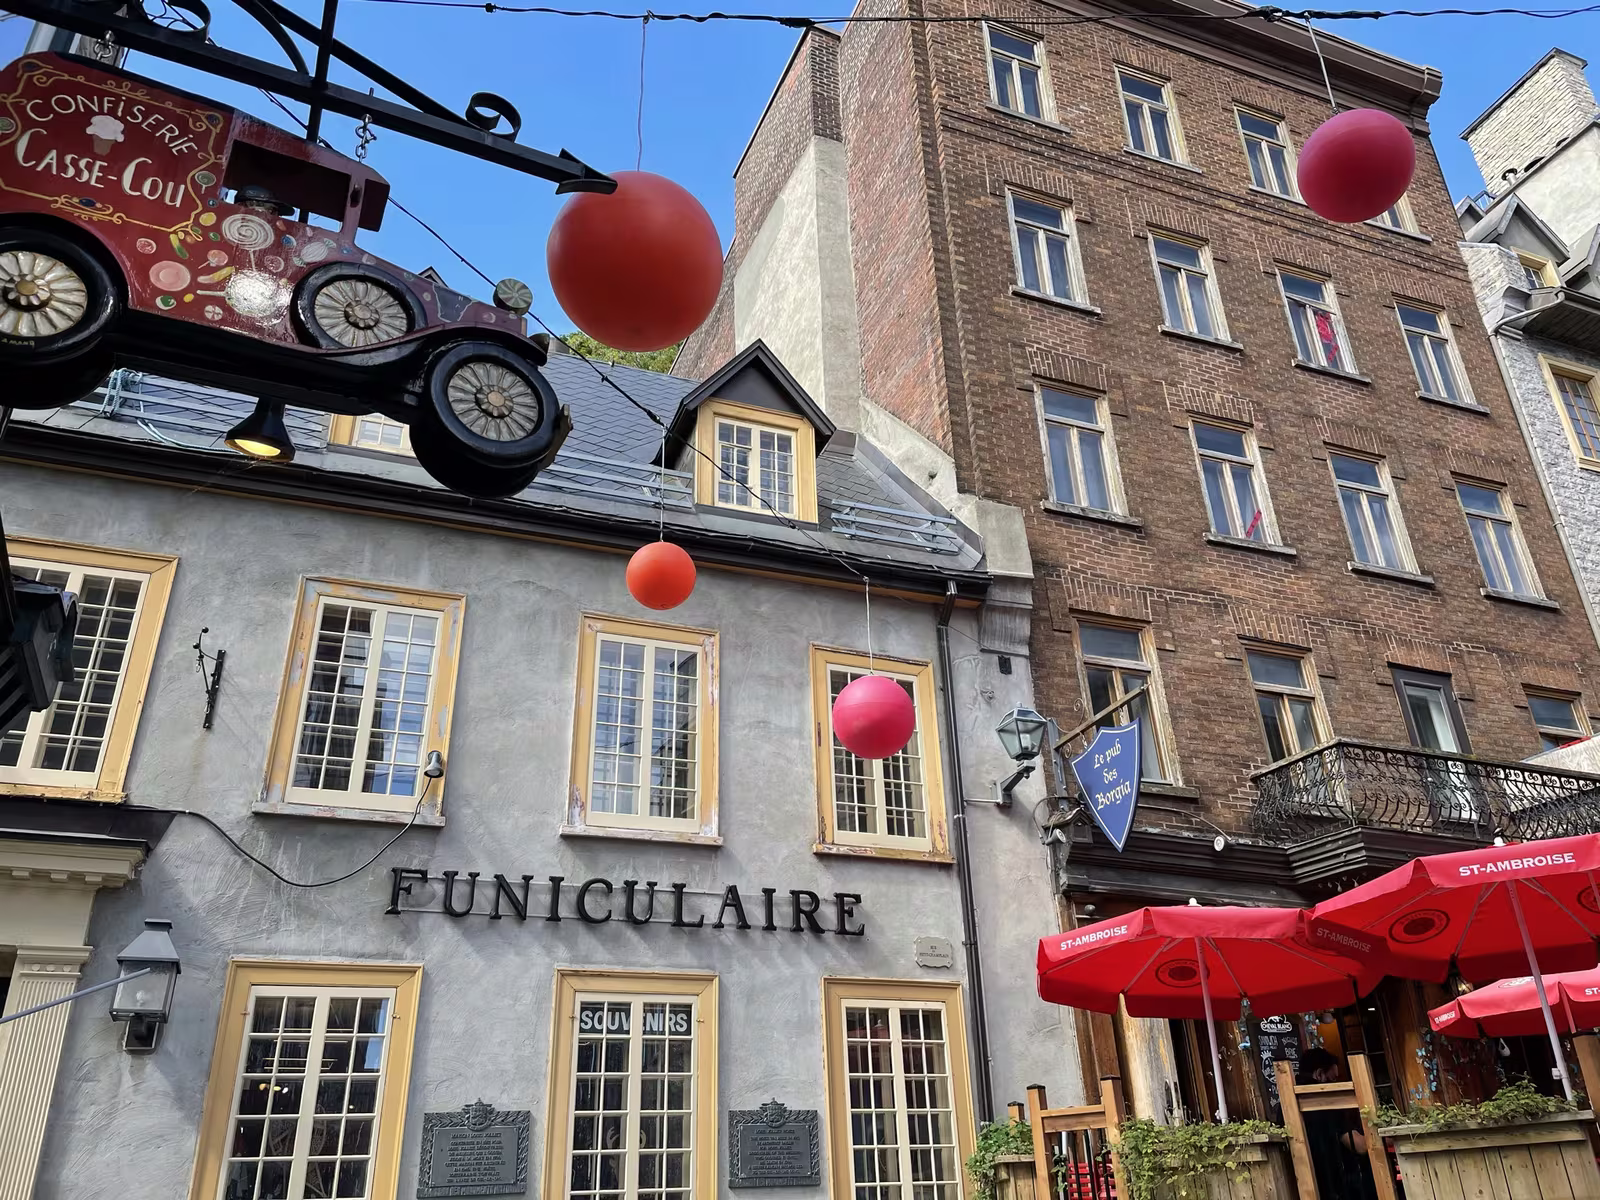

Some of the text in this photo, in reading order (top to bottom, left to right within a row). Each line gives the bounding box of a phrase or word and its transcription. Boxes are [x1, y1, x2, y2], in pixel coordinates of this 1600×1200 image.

[1094, 738, 1122, 769] Le pub
[1103, 768, 1118, 784] des
[1095, 779, 1131, 811] Borgia
[1459, 852, 1576, 877] ST-AMBROISE
[384, 866, 865, 936] FUNICULAIRE
[1060, 925, 1128, 951] ST-AMBROISE
[1316, 927, 1372, 953] ST-AMBROISE
[580, 1010, 689, 1032] SOUVNIRS
